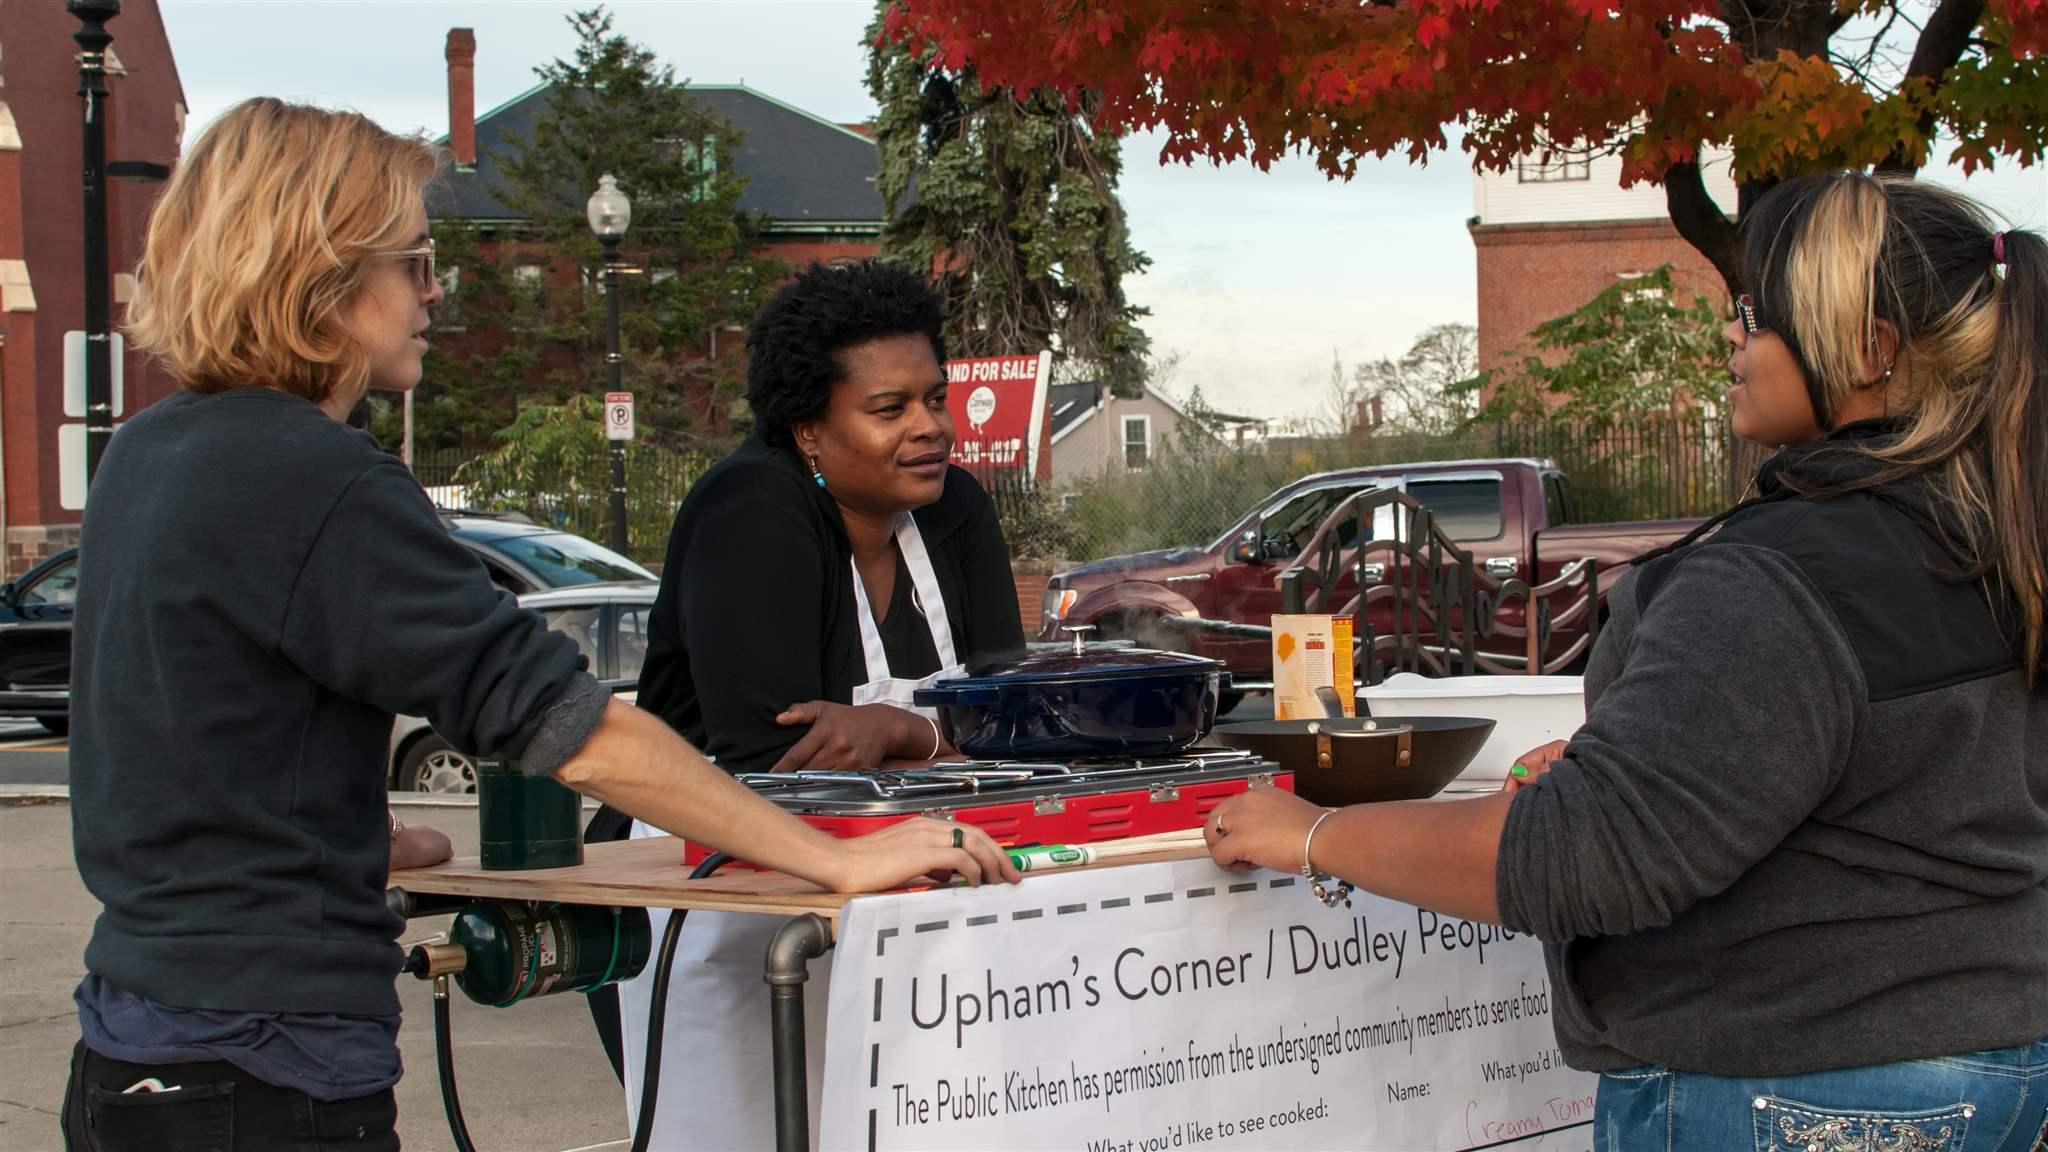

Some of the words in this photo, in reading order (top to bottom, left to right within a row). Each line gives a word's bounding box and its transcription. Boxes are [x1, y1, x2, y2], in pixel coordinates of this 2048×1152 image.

[971, 361, 999, 381] FOR
[1001, 359, 1037, 380] SALE
[911, 955, 1101, 1049] Upham's
[1114, 947, 1252, 1001] Corner
[1289, 915, 1407, 979] Dudley
[892, 1083, 929, 1127] The
[937, 1075, 999, 1122] Public
[1005, 1066, 1069, 1114] Kitchen
[1071, 1060, 1100, 1102] has
[1104, 1046, 1185, 1113] permission
[1188, 1039, 1226, 1080] from
[1229, 1032, 1254, 1073] the
[1258, 1015, 1341, 1075] undersigned
[1345, 1005, 1414, 1056] community
[1417, 996, 1473, 1038] members
[1474, 1000, 1489, 1027] to
[1491, 997, 1520, 1024] serve
[1521, 978, 1549, 1017] food
[1481, 1061, 1516, 1083] What
[1518, 1050, 1550, 1084] you'd
[1387, 1081, 1431, 1104] Name:
[1187, 1120, 1213, 1144] like
[1218, 1121, 1235, 1138] to
[1239, 1116, 1265, 1138] see
[1269, 1097, 1329, 1128] cooked:
[1465, 1100, 1545, 1144] Creamy
